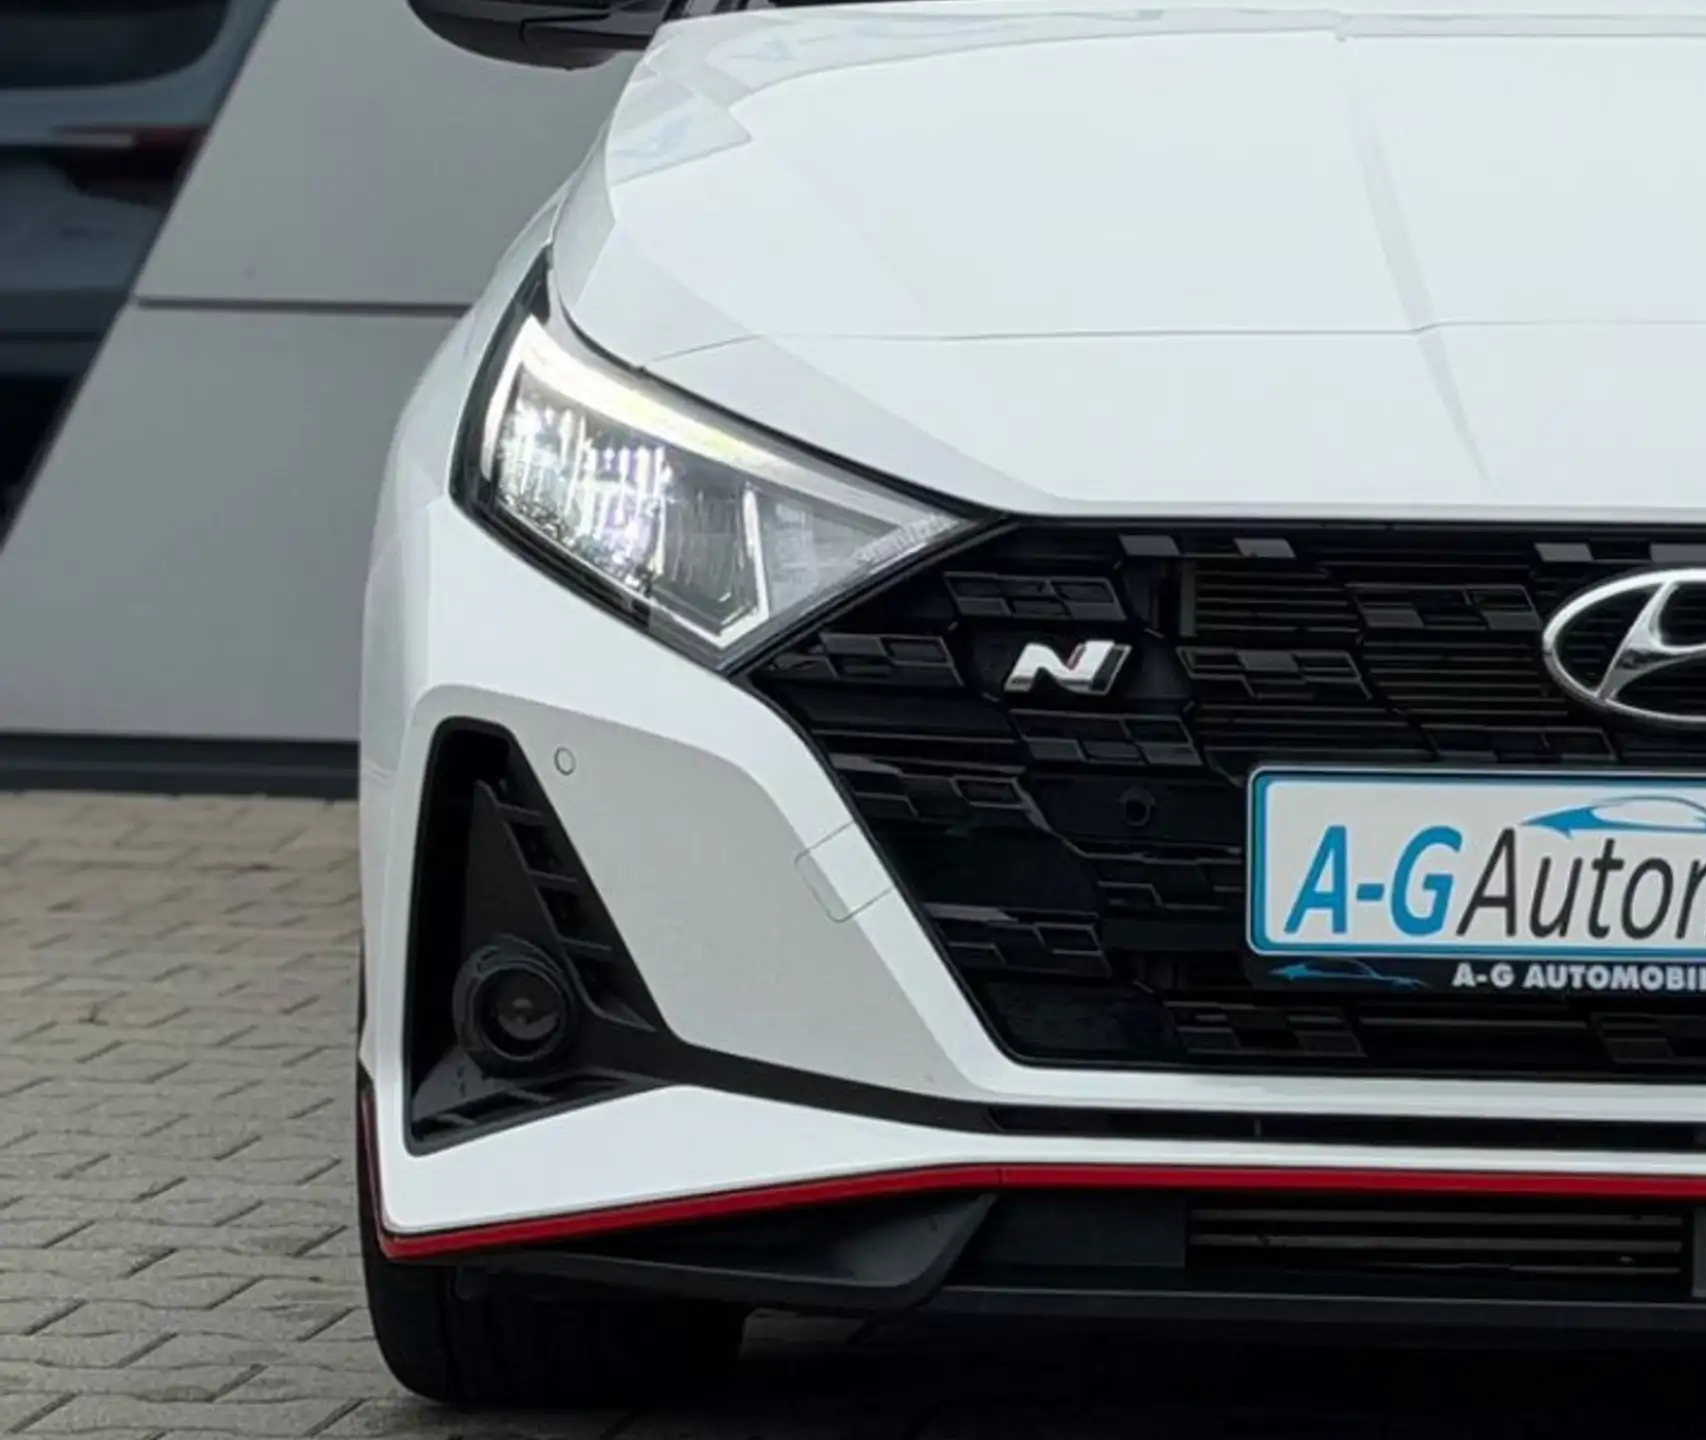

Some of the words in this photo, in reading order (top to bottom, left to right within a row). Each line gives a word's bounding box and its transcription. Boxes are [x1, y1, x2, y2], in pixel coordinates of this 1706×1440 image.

[1004, 639, 1132, 695] N
[1283, 825, 1463, 937] A-G
[1451, 963, 1515, 988] A-G
